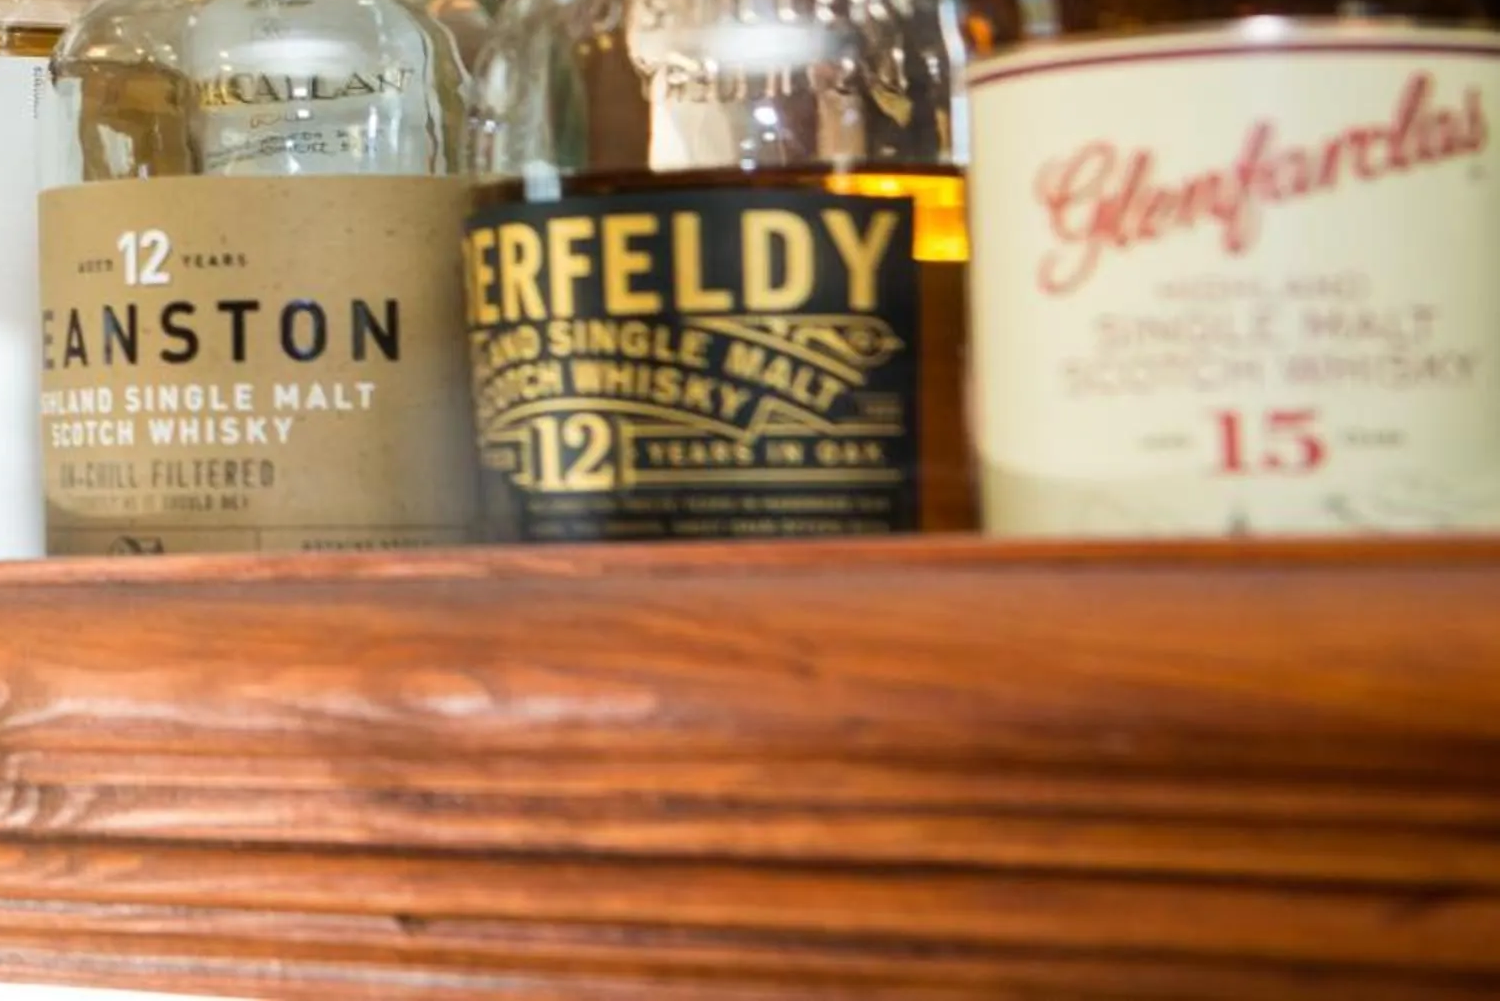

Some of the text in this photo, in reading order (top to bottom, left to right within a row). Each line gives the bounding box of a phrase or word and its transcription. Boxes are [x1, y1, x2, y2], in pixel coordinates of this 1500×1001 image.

[1036, 70, 1487, 293] Glenfarclas
[116, 229, 171, 286] 12
[181, 253, 248, 269] YEARS
[462, 210, 898, 327] ERFELDY
[41, 298, 399, 370] EANSTON
[547, 320, 709, 369] SINGLE
[722, 340, 845, 412] MALT
[124, 383, 255, 413] SINGLE
[274, 381, 376, 411] MALT
[572, 361, 750, 419] WHISKY
[51, 416, 294, 447] SCOTCH WHISKY
[529, 413, 615, 490] 12
[1208, 405, 1328, 477] 15
[151, 460, 275, 489] FILTERED
